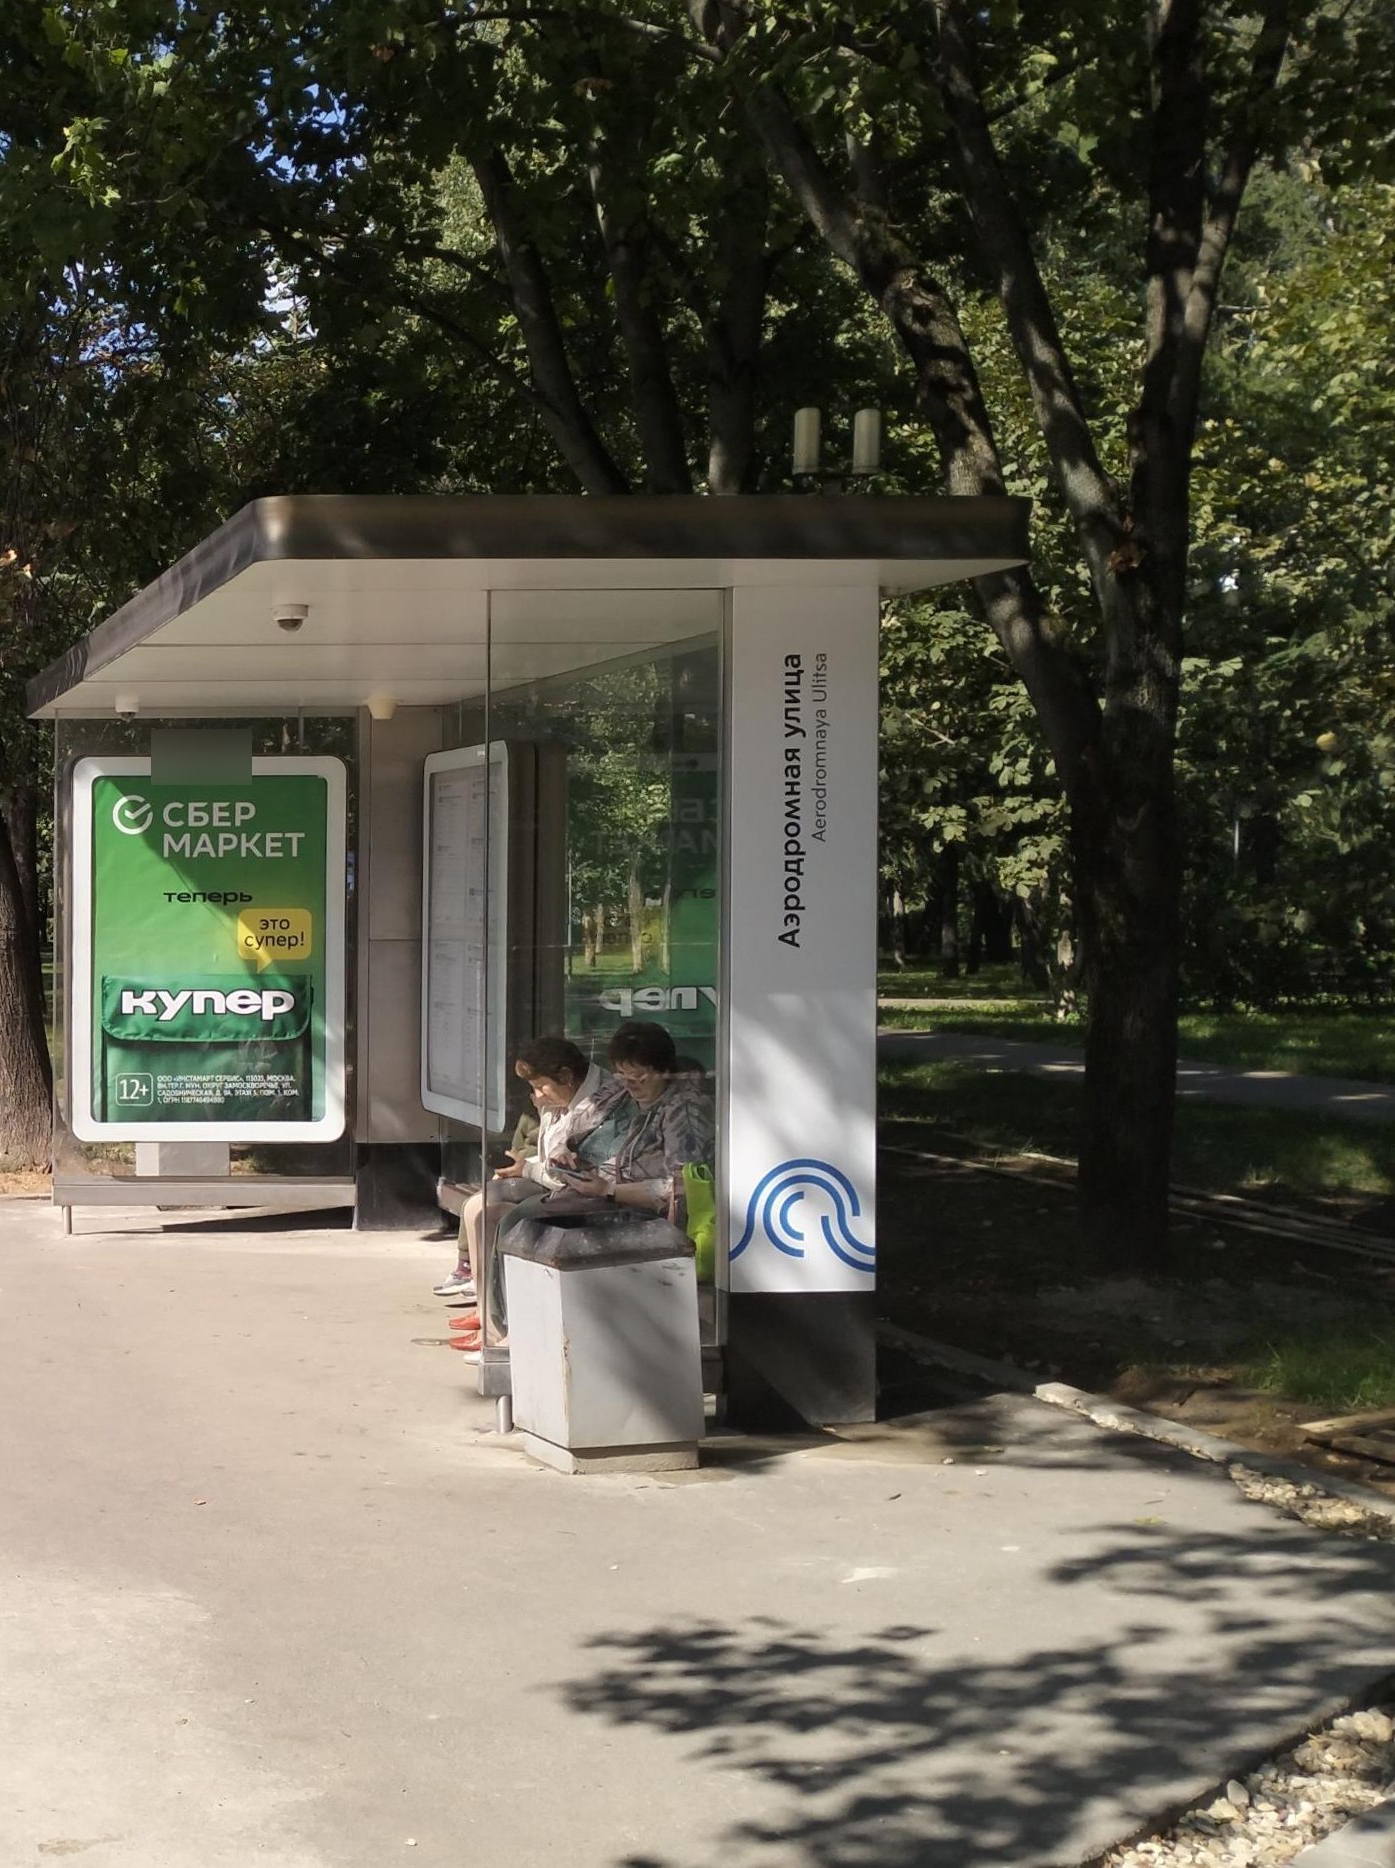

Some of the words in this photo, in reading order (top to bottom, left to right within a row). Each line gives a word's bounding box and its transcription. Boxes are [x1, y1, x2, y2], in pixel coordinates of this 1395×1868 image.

[811, 652, 828, 702] Ulitsa
[784, 653, 806, 738] улица
[811, 709, 830, 842] Aerodromnaya
[162, 802, 257, 828] СБЕР
[162, 832, 306, 858] МАРКЕТ
[778, 748, 806, 948] Аэродромная
[163, 891, 253, 905] теперь
[259, 918, 291, 930] это
[244, 931, 305, 950] супер!
[120, 988, 296, 1021] купер
[119, 1079, 149, 1100] 12+
